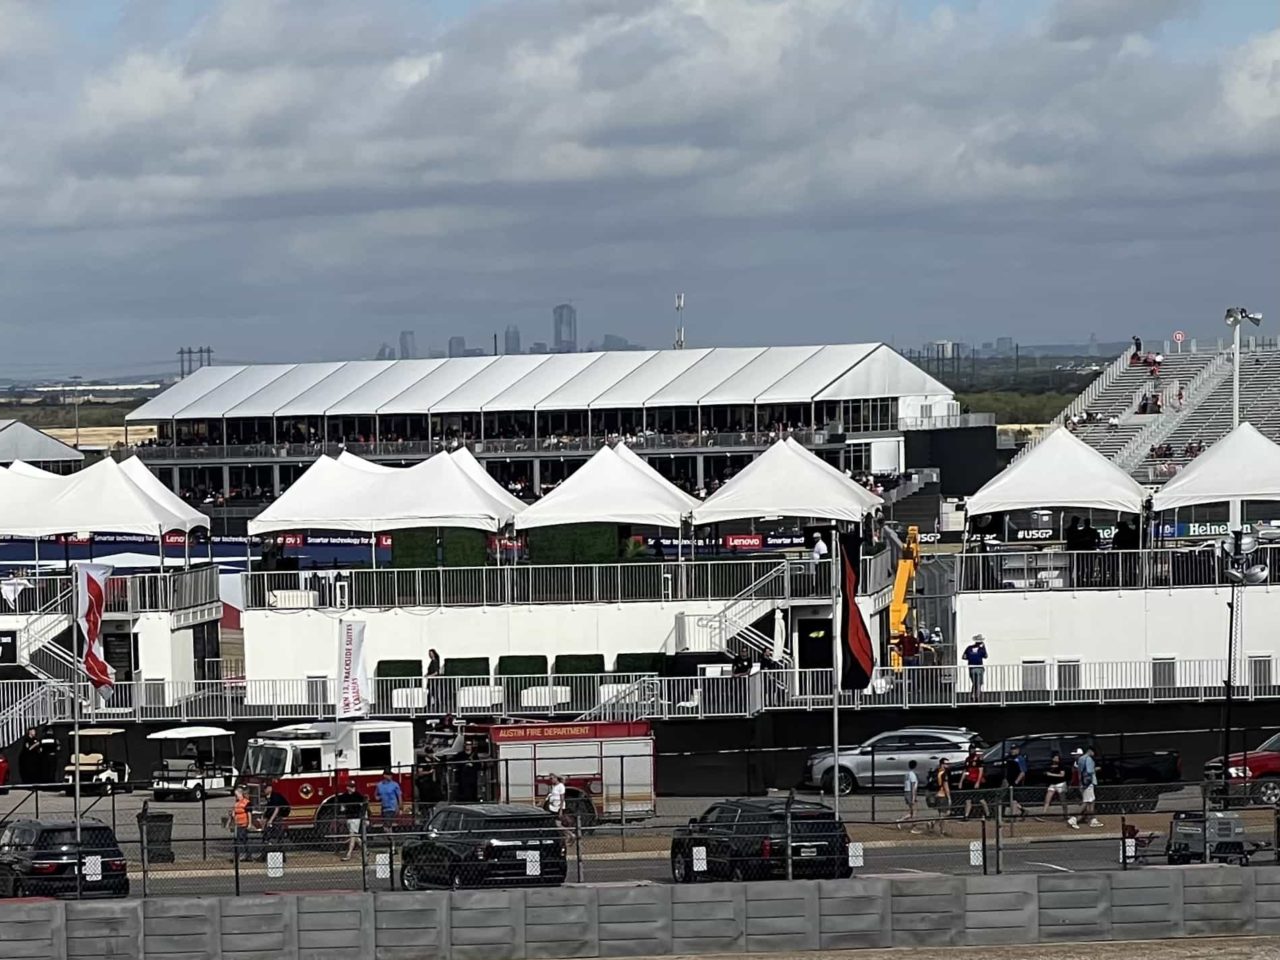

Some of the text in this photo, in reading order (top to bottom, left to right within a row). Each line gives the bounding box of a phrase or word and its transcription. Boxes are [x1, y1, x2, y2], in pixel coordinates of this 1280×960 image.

[729, 537, 760, 546] Lenovo
[767, 537, 791, 545] Smarter
[500, 726, 590, 737] AUSTIN FIRE DEPARTMENT
